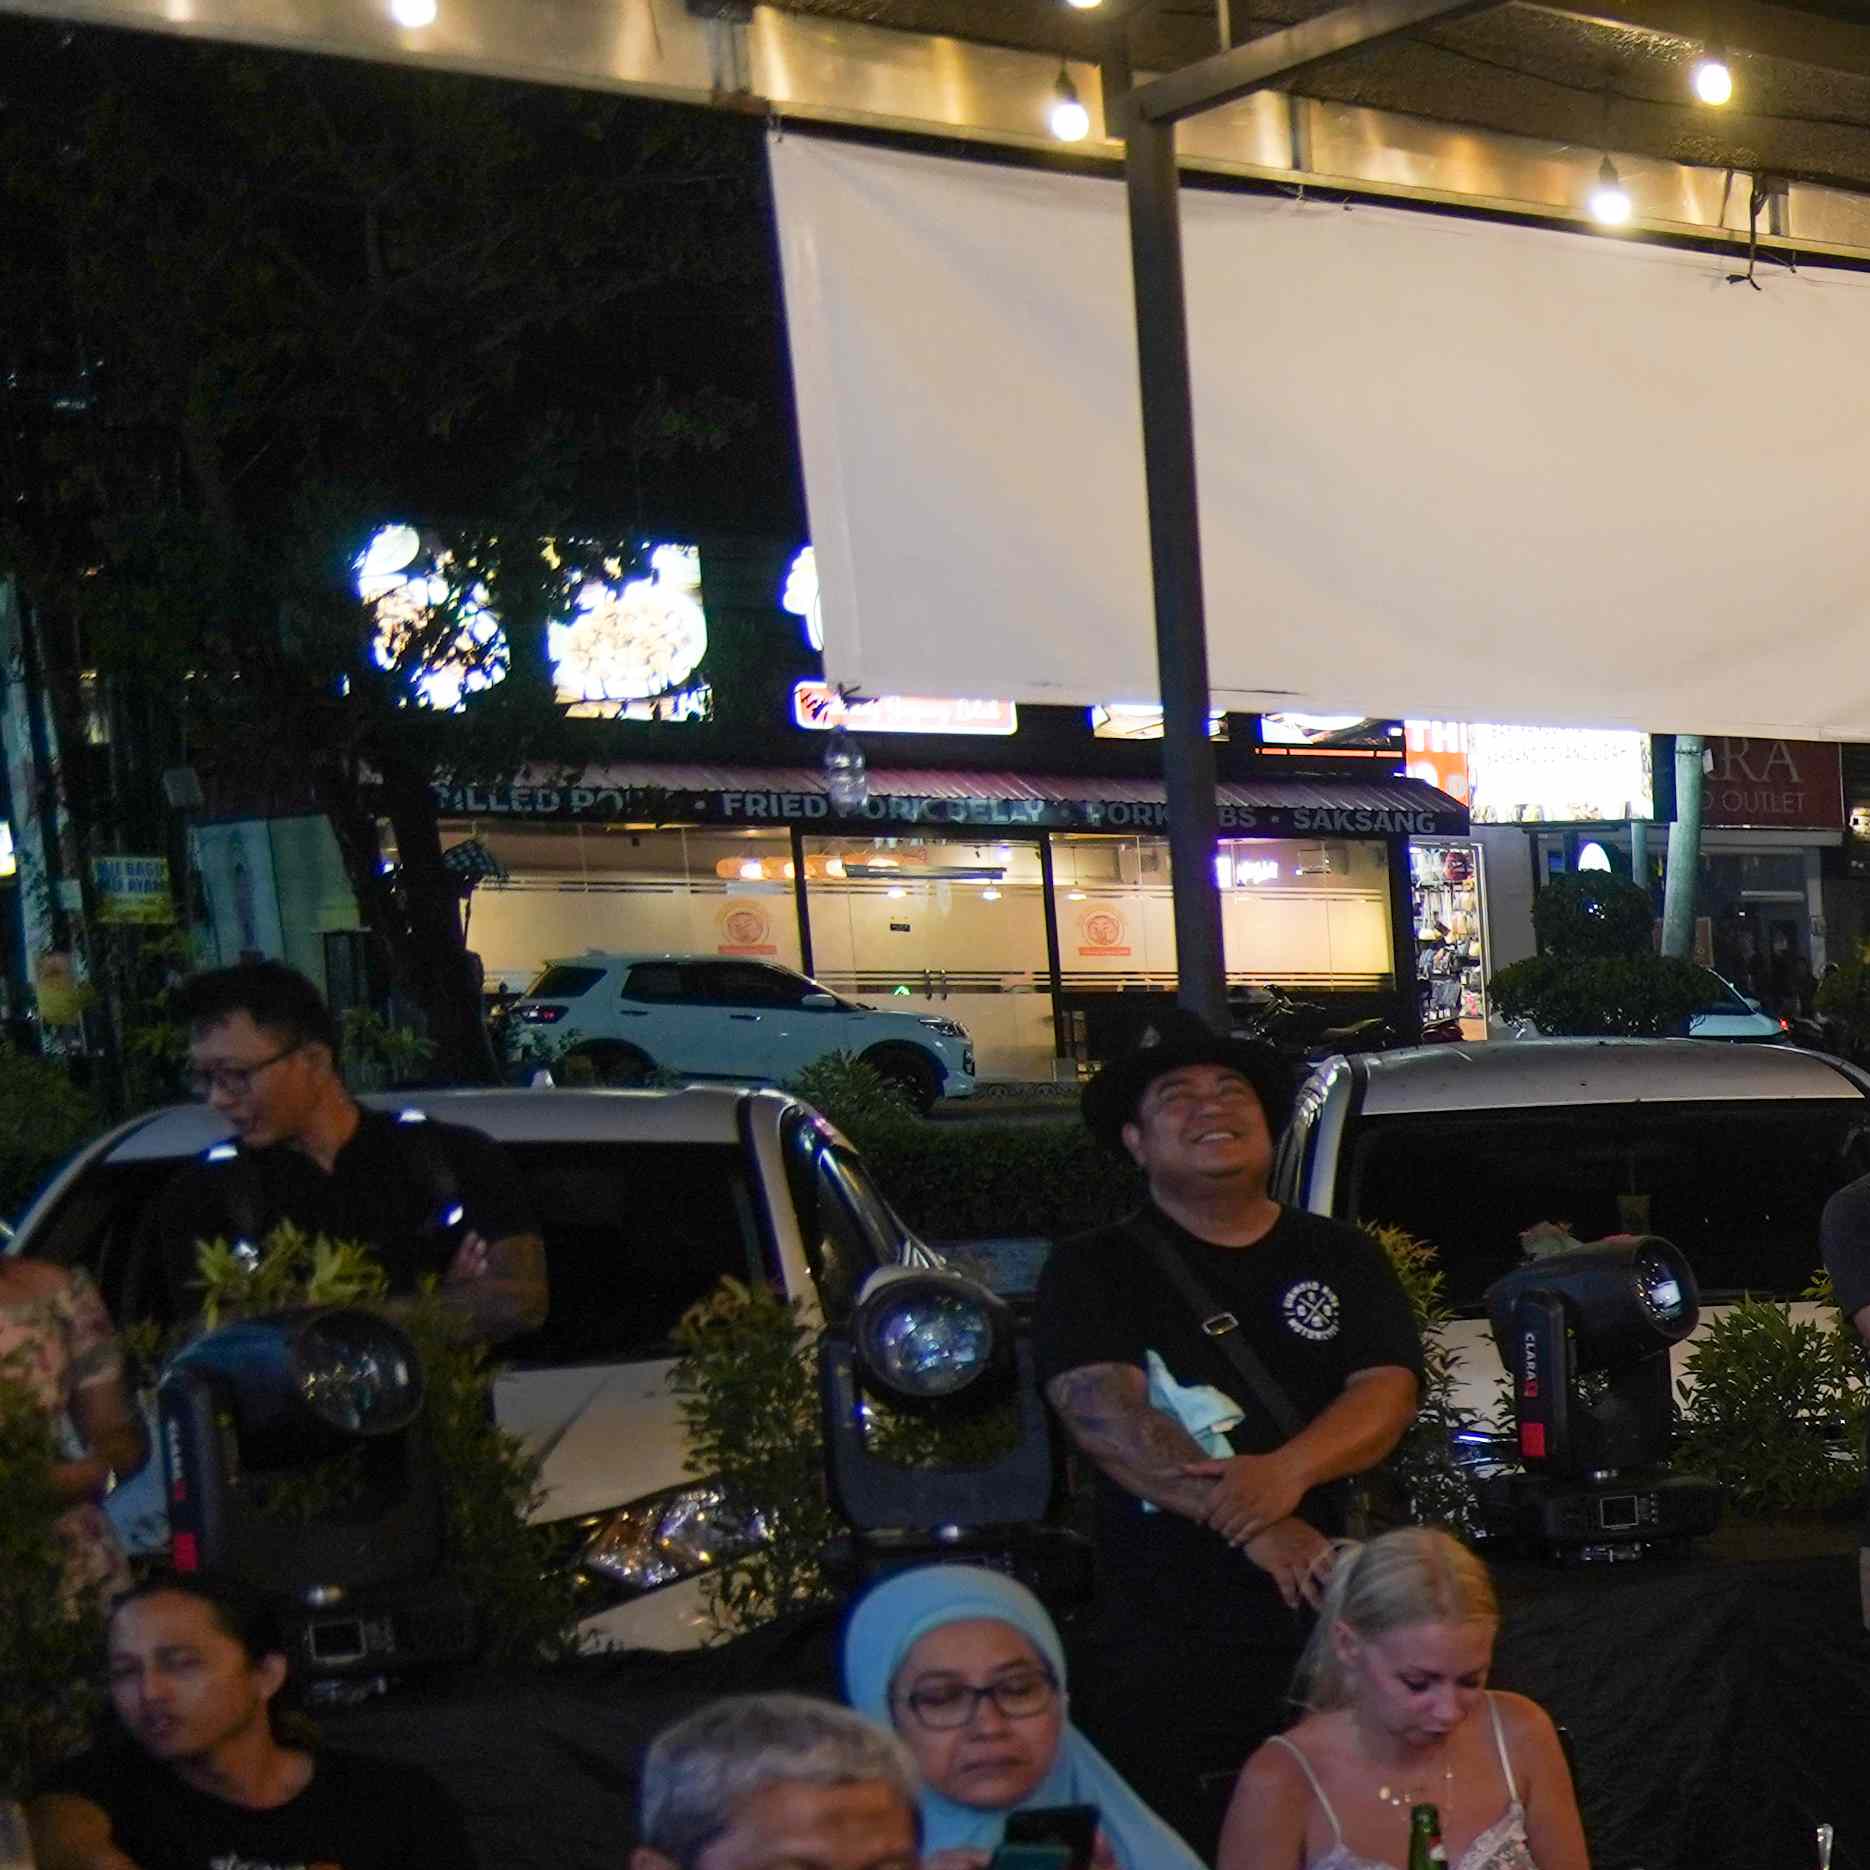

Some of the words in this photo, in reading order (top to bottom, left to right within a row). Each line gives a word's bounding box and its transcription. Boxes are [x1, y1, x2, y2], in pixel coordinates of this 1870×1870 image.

[722, 793, 829, 818] FRIED
[946, 799, 1044, 823] BELLY
[1293, 807, 1437, 834] SAKSANG
[1721, 790, 1808, 814] OUTLET
